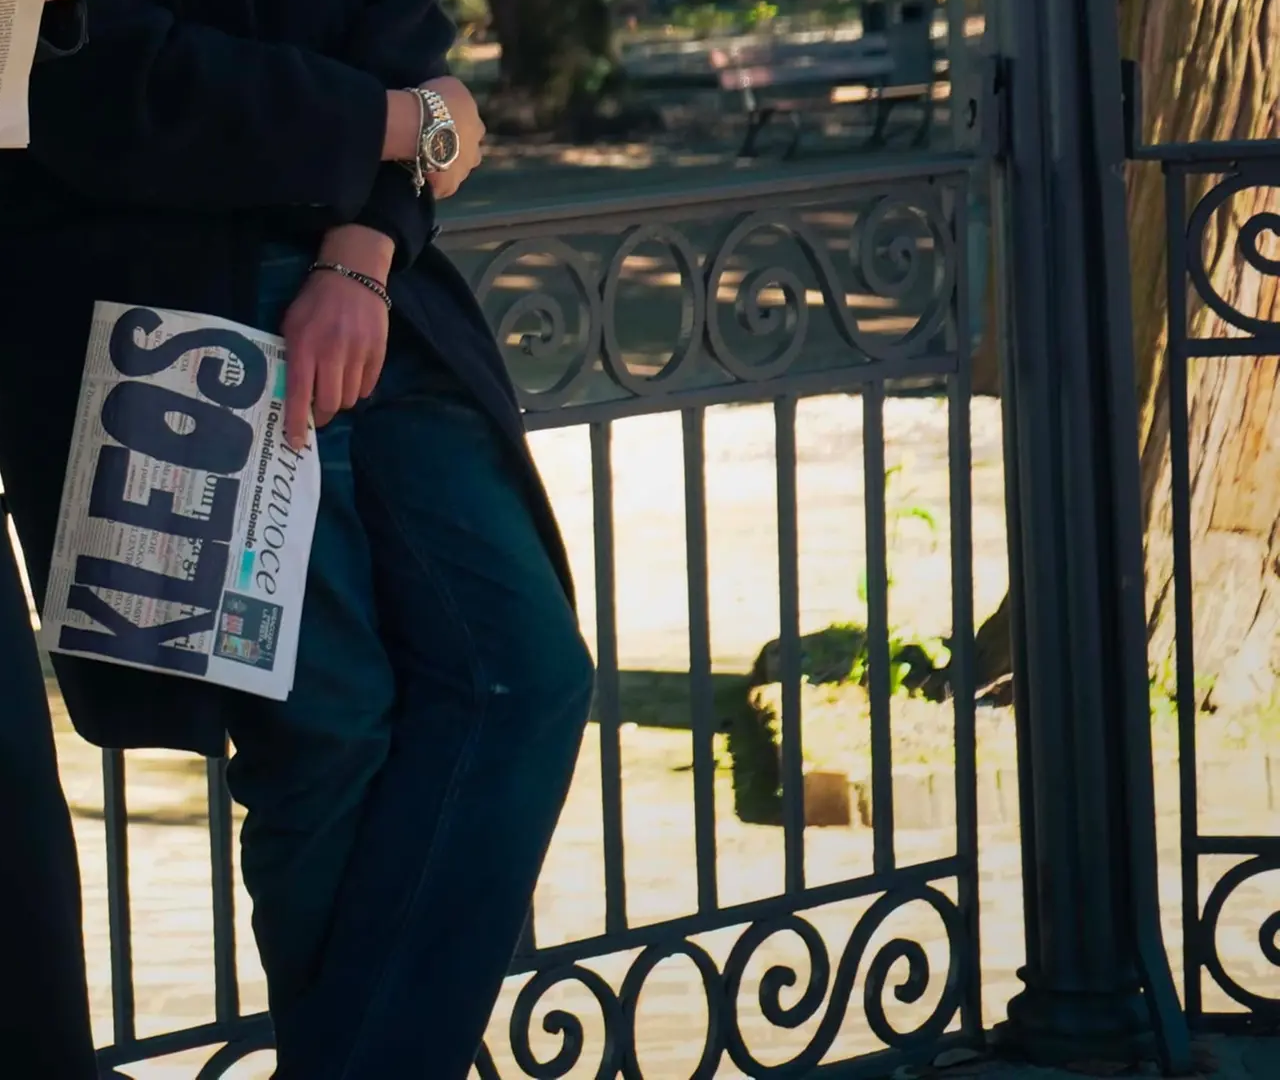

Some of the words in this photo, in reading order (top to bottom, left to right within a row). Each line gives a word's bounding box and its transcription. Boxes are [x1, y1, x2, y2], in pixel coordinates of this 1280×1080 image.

[257, 412, 279, 482] Quotidiano
[59, 307, 268, 676] KLEOS
[245, 482, 267, 550] nazionale
